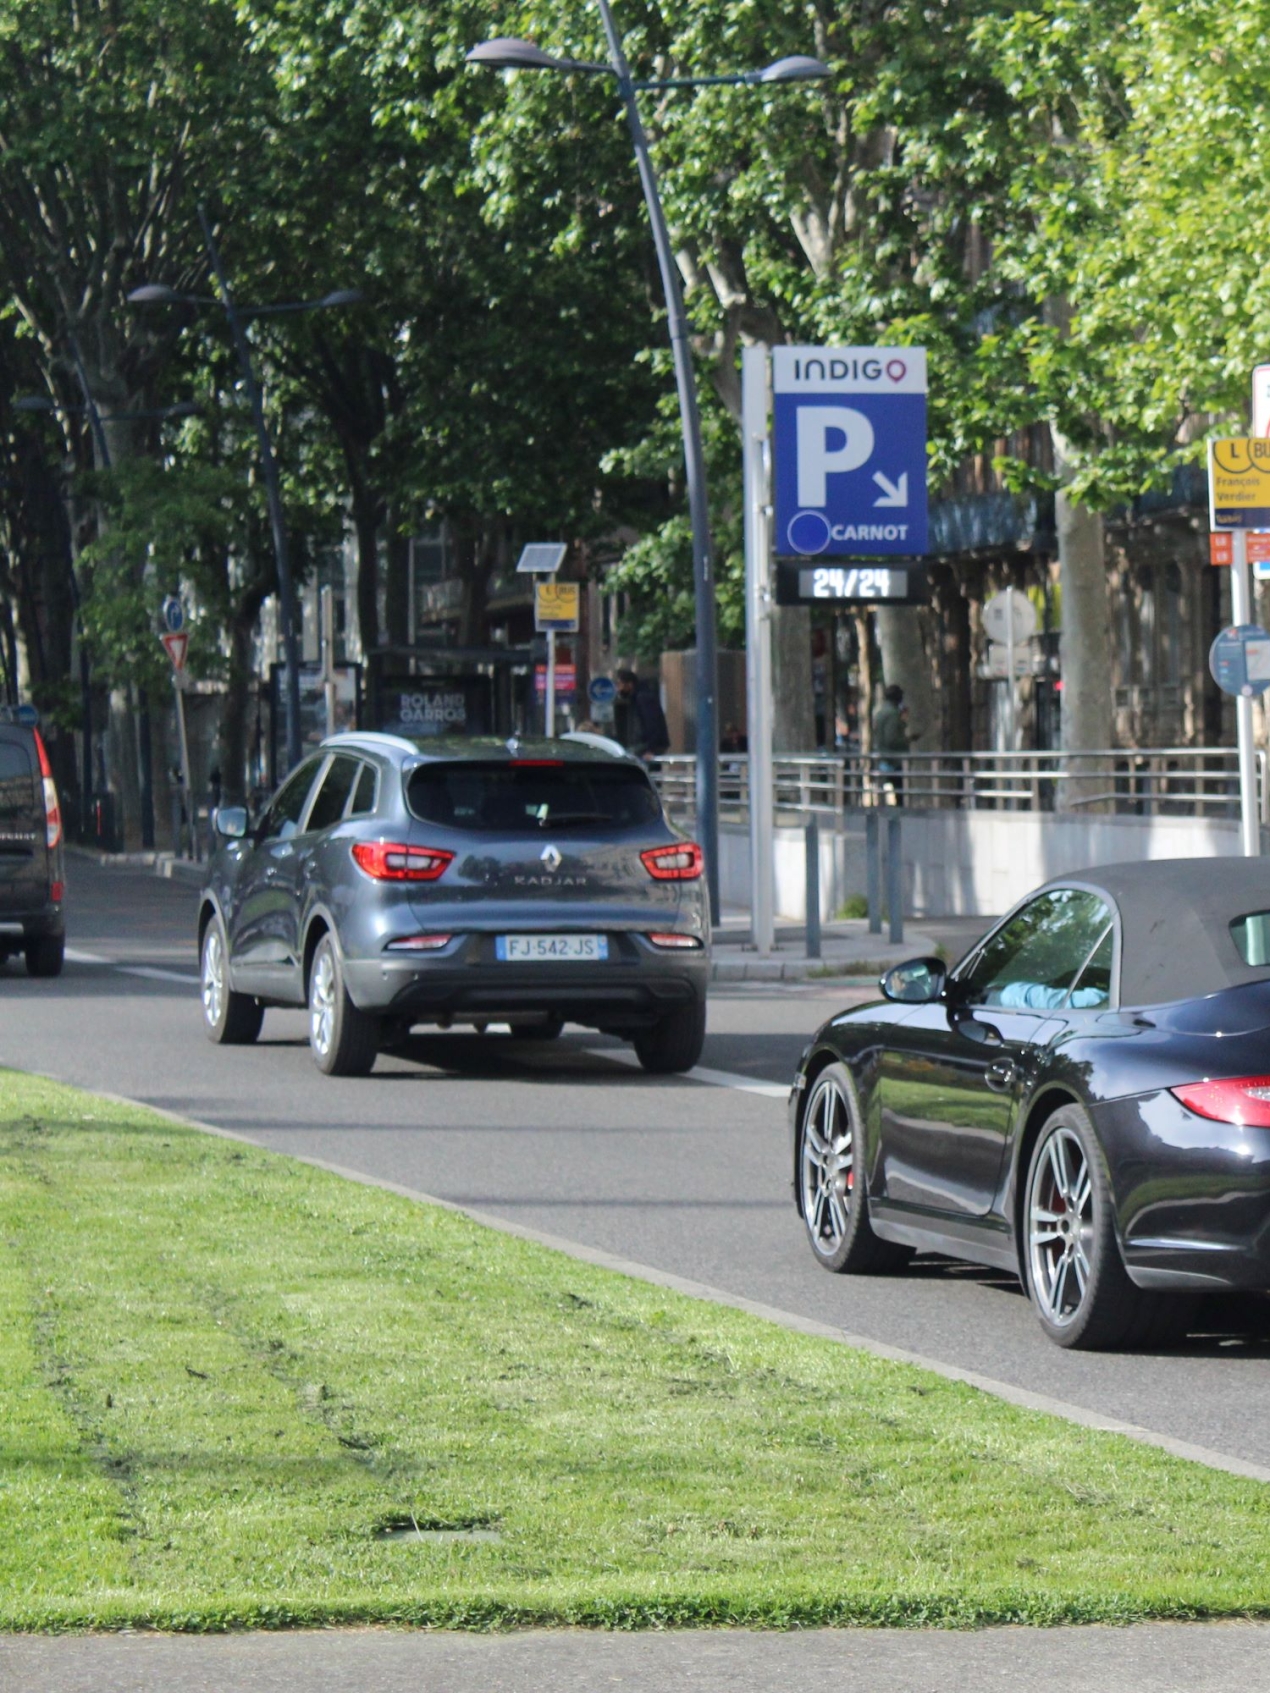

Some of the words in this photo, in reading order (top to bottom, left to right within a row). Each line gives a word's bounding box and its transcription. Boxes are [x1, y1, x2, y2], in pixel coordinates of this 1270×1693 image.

[794, 359, 907, 384] INDIGO
[796, 406, 875, 507] P
[1216, 476, 1260, 488] François
[1216, 491, 1256, 502] Verdier
[831, 524, 909, 541] CARNOT
[813, 567, 891, 598] 24/24
[400, 693, 466, 708] ROLAND
[400, 708, 466, 722] GARROS
[514, 876, 587, 886] KADJAR
